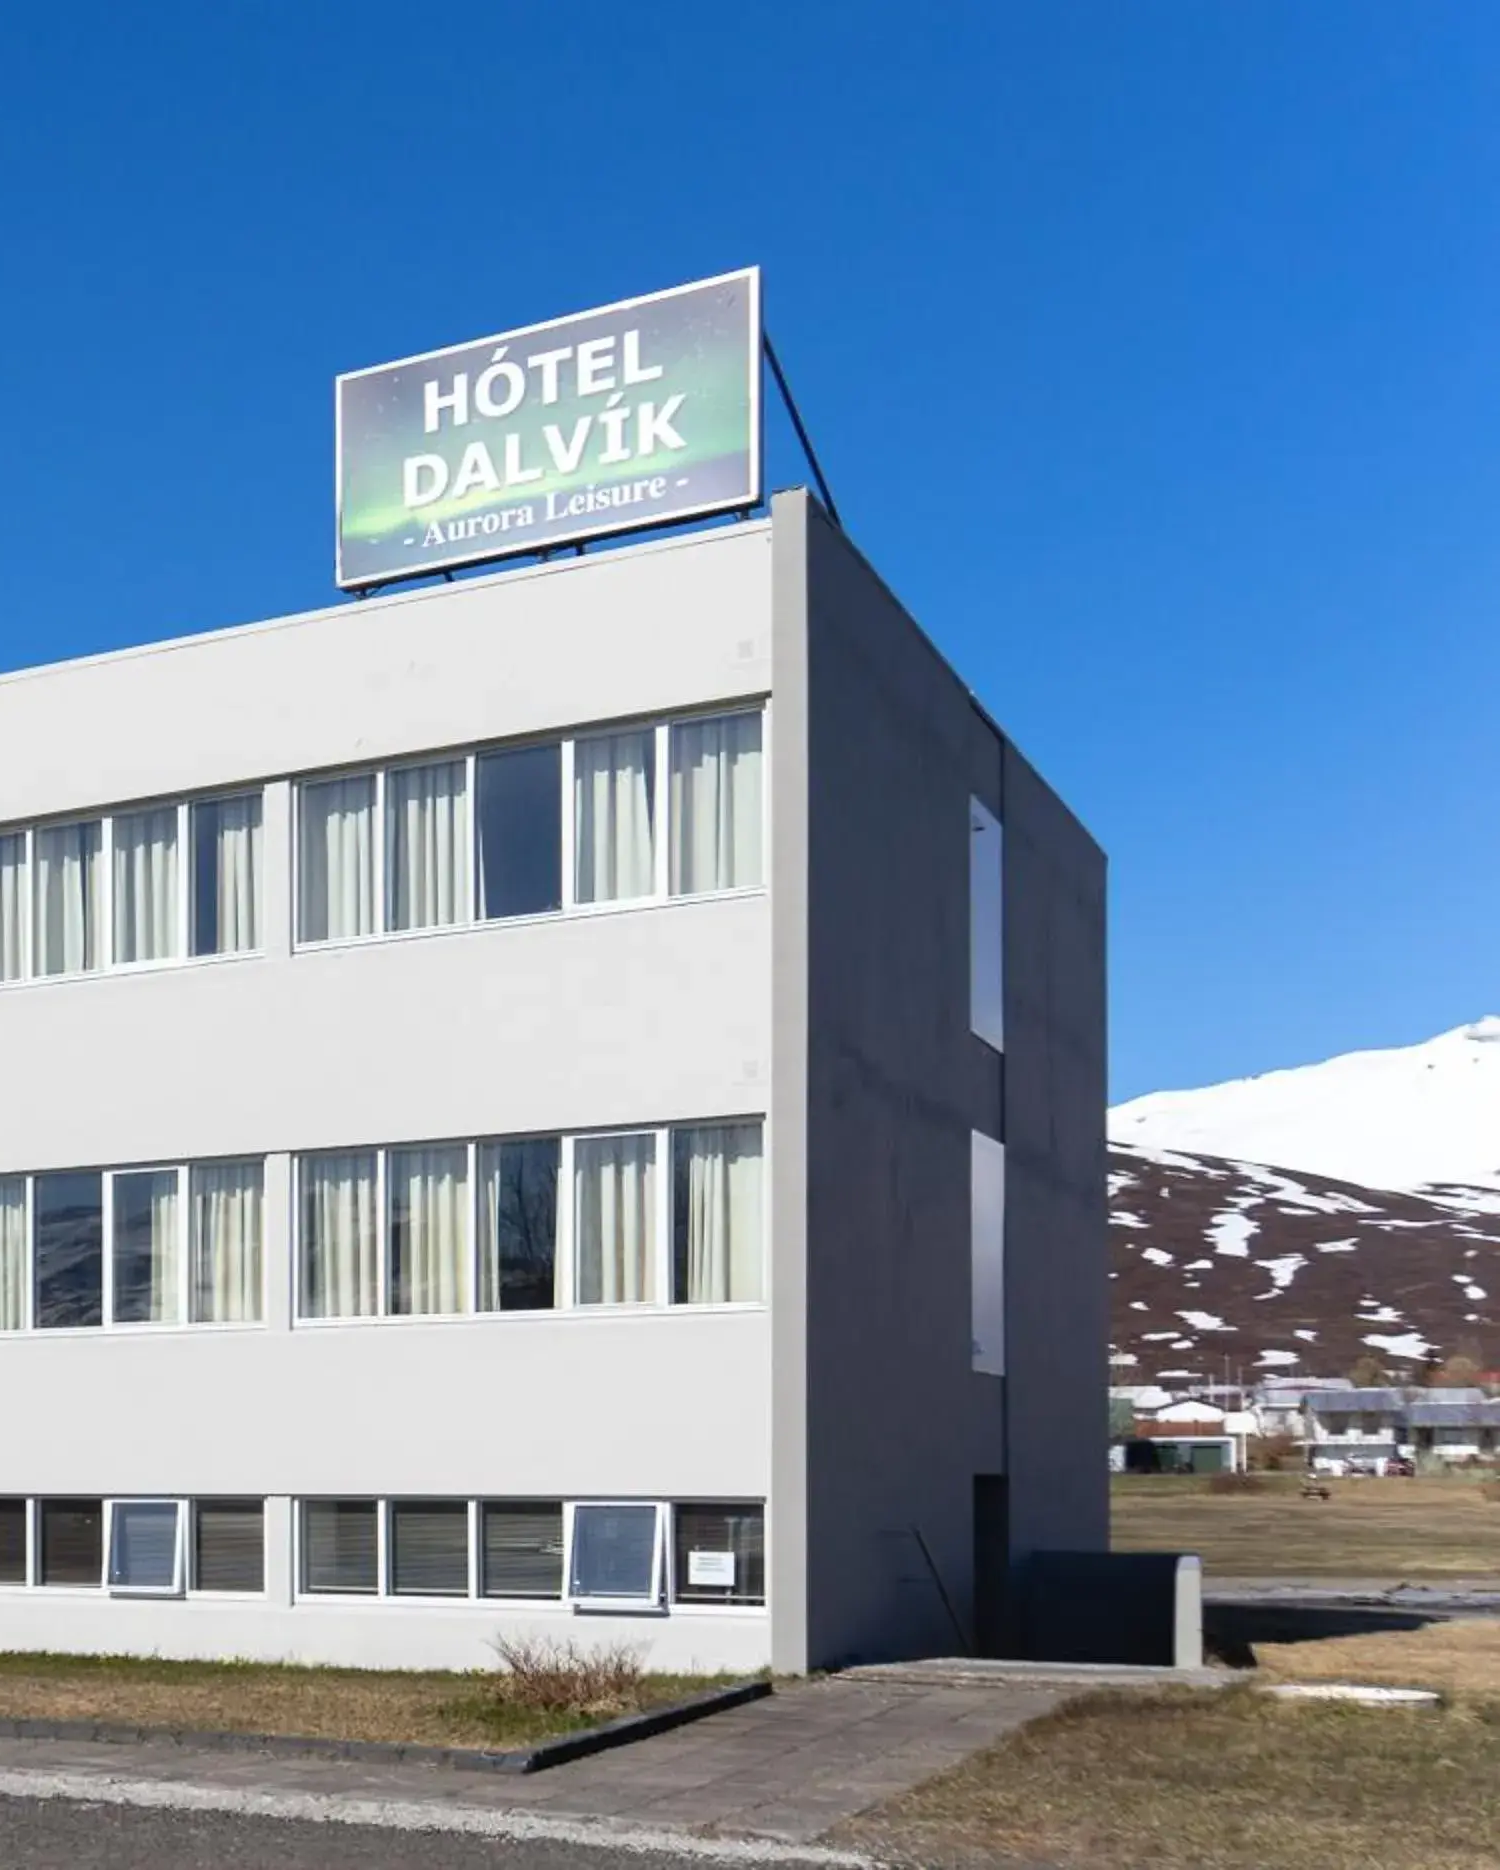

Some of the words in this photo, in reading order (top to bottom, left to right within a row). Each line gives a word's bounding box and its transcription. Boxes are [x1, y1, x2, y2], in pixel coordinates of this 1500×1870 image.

[424, 329, 662, 433] HÓTEL
[403, 393, 687, 509] DALVÍK
[422, 506, 533, 547] Aurora
[546, 475, 666, 520] Leisure
